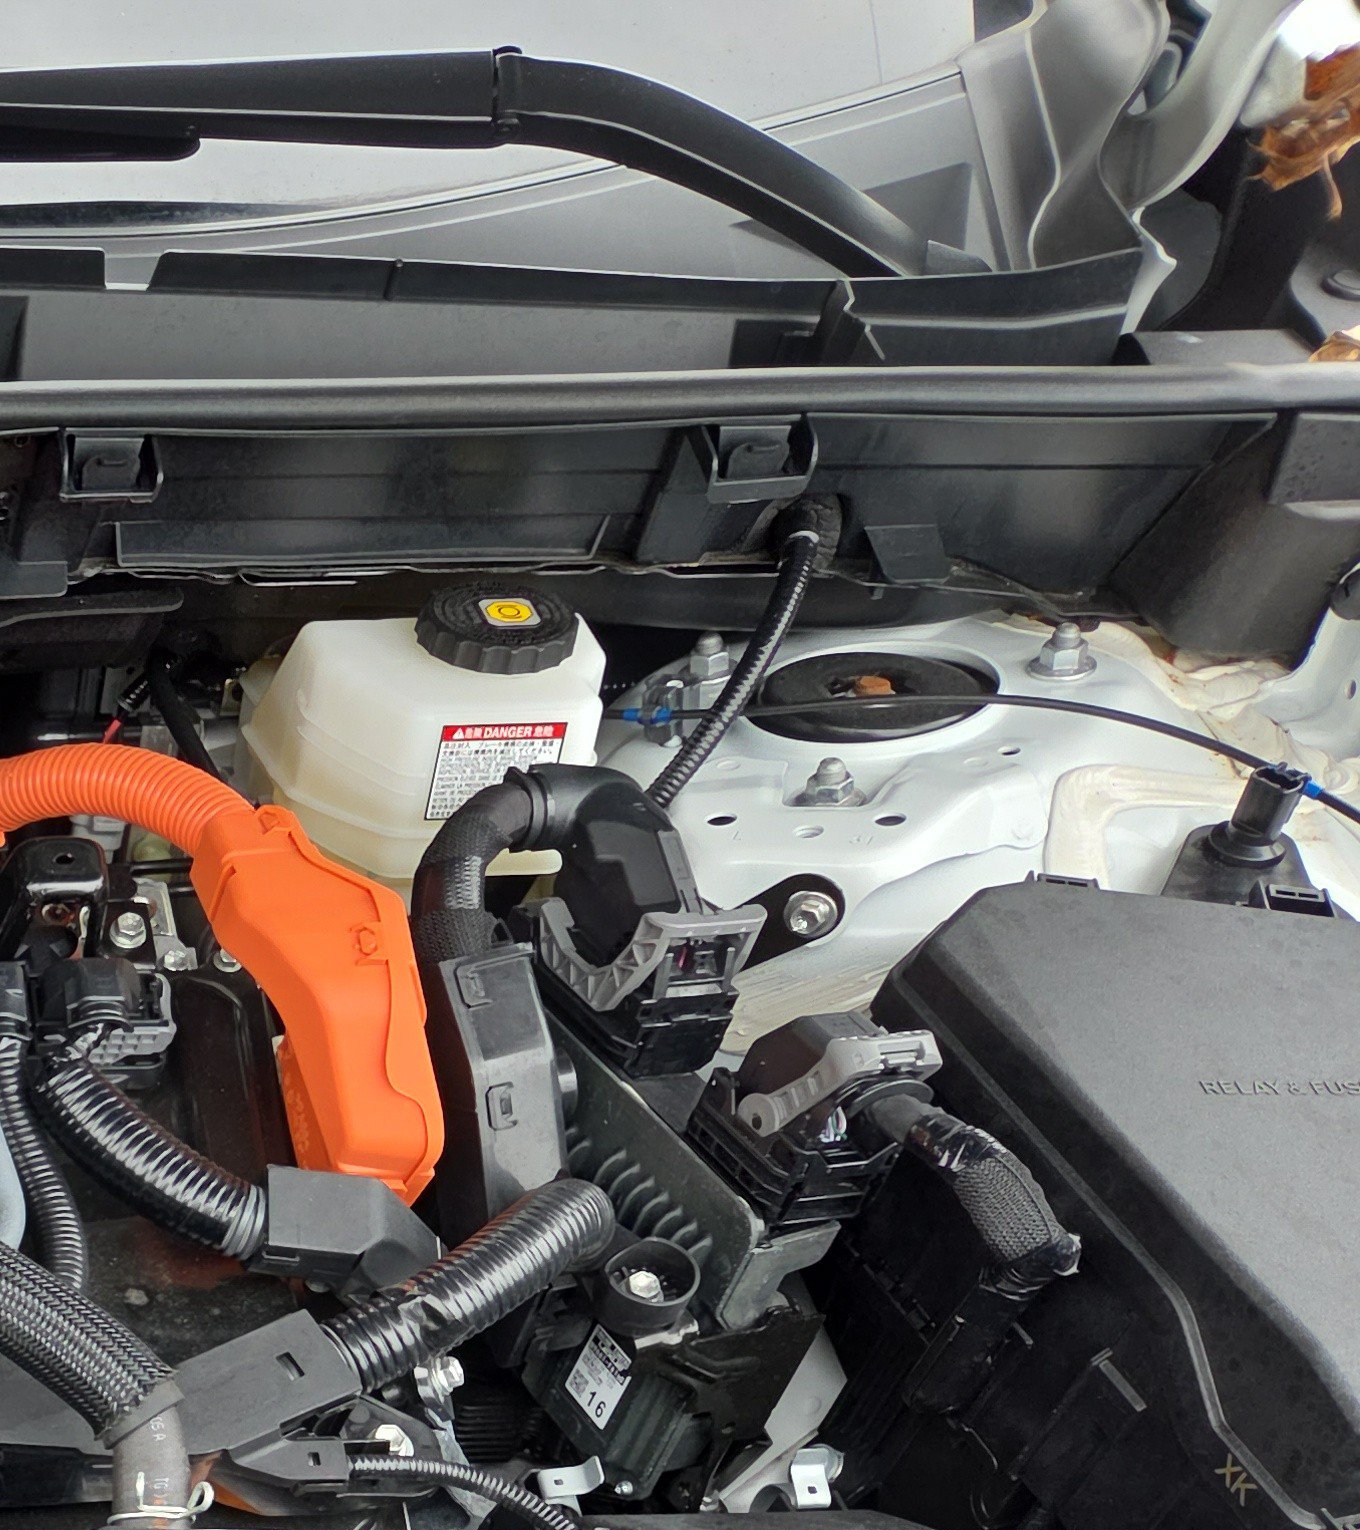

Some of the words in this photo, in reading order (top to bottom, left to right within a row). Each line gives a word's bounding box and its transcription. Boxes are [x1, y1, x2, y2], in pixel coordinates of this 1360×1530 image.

[484, 726, 532, 739] DANGER
[1199, 1080, 1279, 1095] RELAY
[1287, 1081, 1307, 1095] &
[1309, 1081, 1360, 1096] FUS
